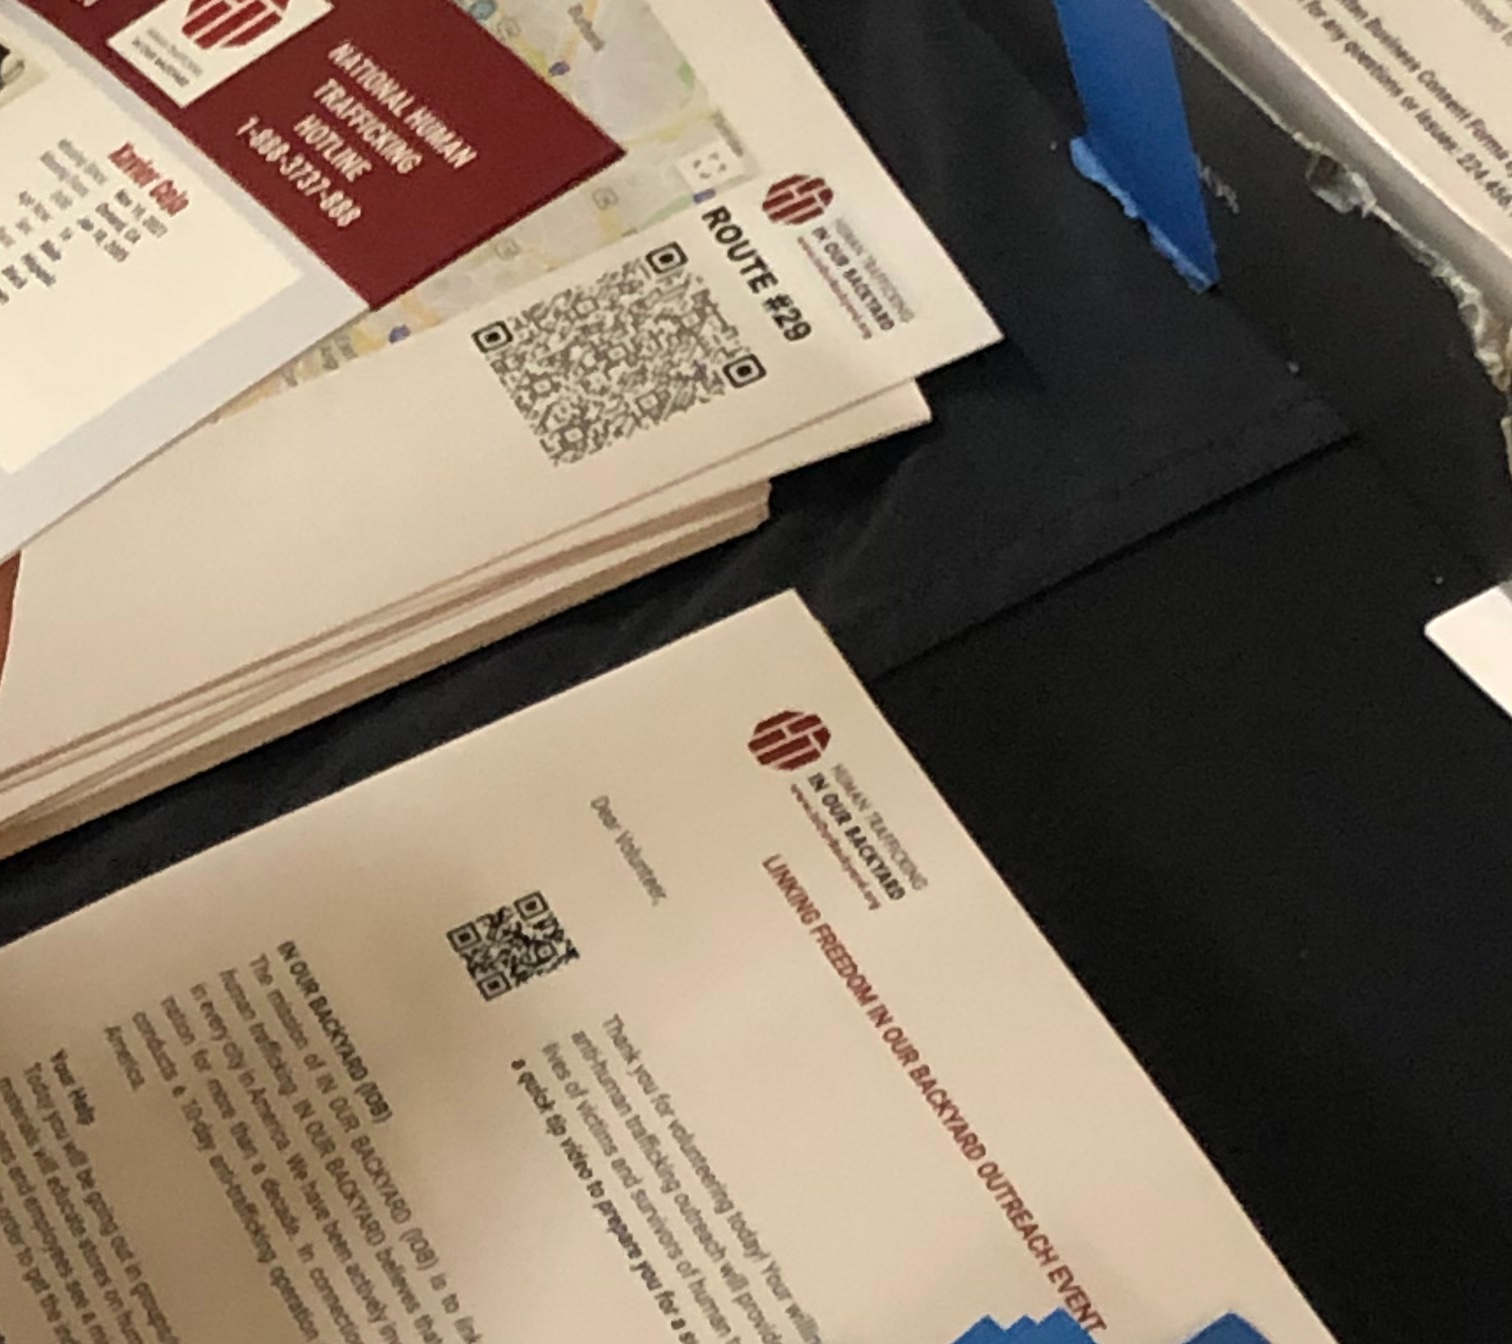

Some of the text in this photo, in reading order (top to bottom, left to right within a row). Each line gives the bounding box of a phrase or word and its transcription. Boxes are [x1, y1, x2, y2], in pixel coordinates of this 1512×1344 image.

[310, 78, 424, 176] TRAFFICKING
[324, 40, 478, 170] NATIONAL HUMAN
[291, 113, 371, 182] HOTLINE
[230, 116, 364, 228] 1-888-3737-888
[700, 202, 814, 346] ROUTE #29
[842, 266, 896, 334] BACKYARD
[588, 794, 672, 906] Dear Volunteer,
[806, 772, 907, 903] IN OUR BACKYARD
[276, 939, 300, 962] IN
[287, 959, 320, 998] OUR
[307, 995, 369, 1083] BACKYARD
[540, 1042, 576, 1081] lives
[600, 1013, 644, 1063] Thank
[511, 1058, 527, 1070] a
[627, 1064, 658, 1096] you
[515, 1068, 557, 1115] quick
[563, 1078, 588, 1101] of
[649, 1091, 679, 1119] for
[761, 853, 1108, 1337] LINKING FREEDOM IN OUR BACKYARD OUTREACH EVENT
[541, 1111, 571, 1138] tip
[574, 1097, 623, 1157] victims
[559, 1135, 598, 1180] video
[570, 1028, 638, 1116] anti-human
[620, 1114, 686, 1195] trafficking
[672, 1189, 729, 1263] outreach
[715, 1259, 749, 1293] will
[609, 1154, 643, 1189] and
[661, 1116, 738, 1216] volunteering
[585, 1178, 610, 1200] to
[592, 1198, 642, 1262] prepare
[629, 1186, 687, 1261] survivors
[630, 1260, 661, 1294] you
[673, 1257, 699, 1280] of
[756, 1261, 795, 1304] Your
[653, 1289, 682, 1318] for
[668, 1317, 686, 1331] a
[685, 1277, 735, 1338] human
